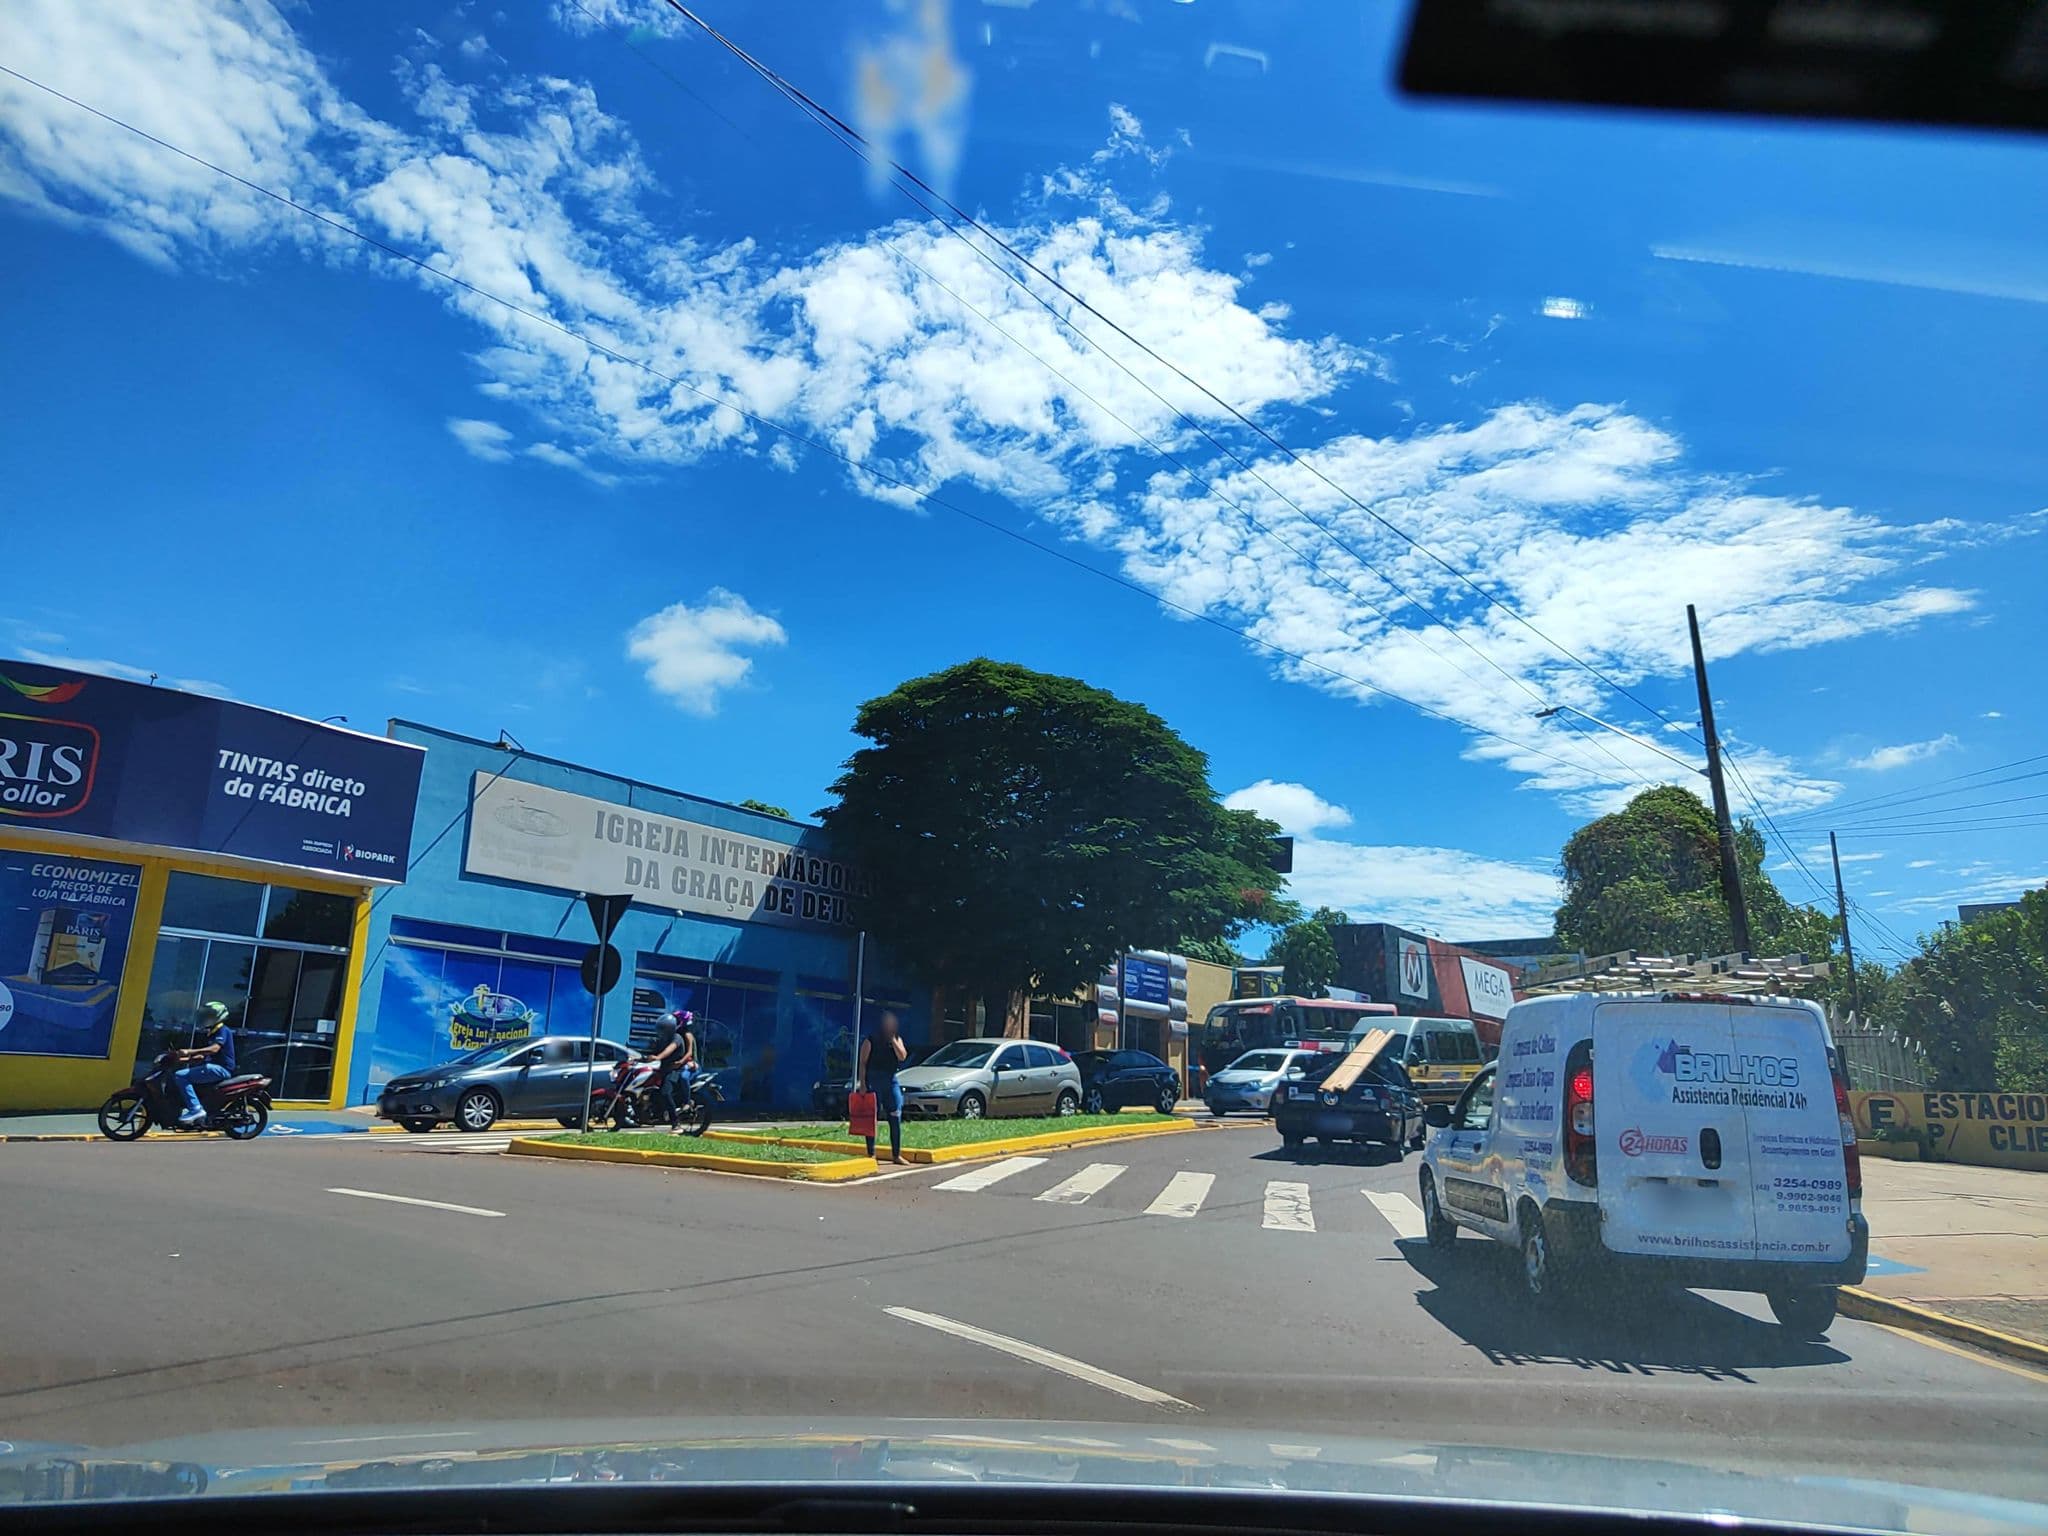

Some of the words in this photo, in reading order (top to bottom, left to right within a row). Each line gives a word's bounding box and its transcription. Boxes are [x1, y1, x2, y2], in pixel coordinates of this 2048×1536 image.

[219, 749, 299, 783] TINTAS
[302, 769, 366, 797] direto
[0, 781, 66, 806] ollor
[224, 777, 254, 798] da
[259, 782, 351, 817] FÁBRICA
[355, 849, 397, 864] BIOPARK
[595, 810, 689, 858] IGREJA
[700, 835, 879, 898] INTERNACION
[32, 887, 58, 900] LOJA
[61, 891, 77, 901] DA
[51, 880, 94, 894] PREÇOS
[97, 884, 113, 895] DE
[624, 855, 660, 890] DA
[672, 864, 755, 912] GRAÇA
[763, 884, 795, 916] DE
[66, 925, 101, 937] PARIS
[1474, 970, 1506, 999] MEGA
[475, 1026, 530, 1039] Intnacional
[1674, 1053, 1800, 1088] BRILHOS
[1789, 1091, 1807, 1110] 24h
[1923, 1093, 2048, 1121] ESTACIO
[1869, 1099, 1896, 1129] E
[1645, 1138, 1689, 1153] HORAS
[1773, 1177, 1842, 1191] 3254-0989
